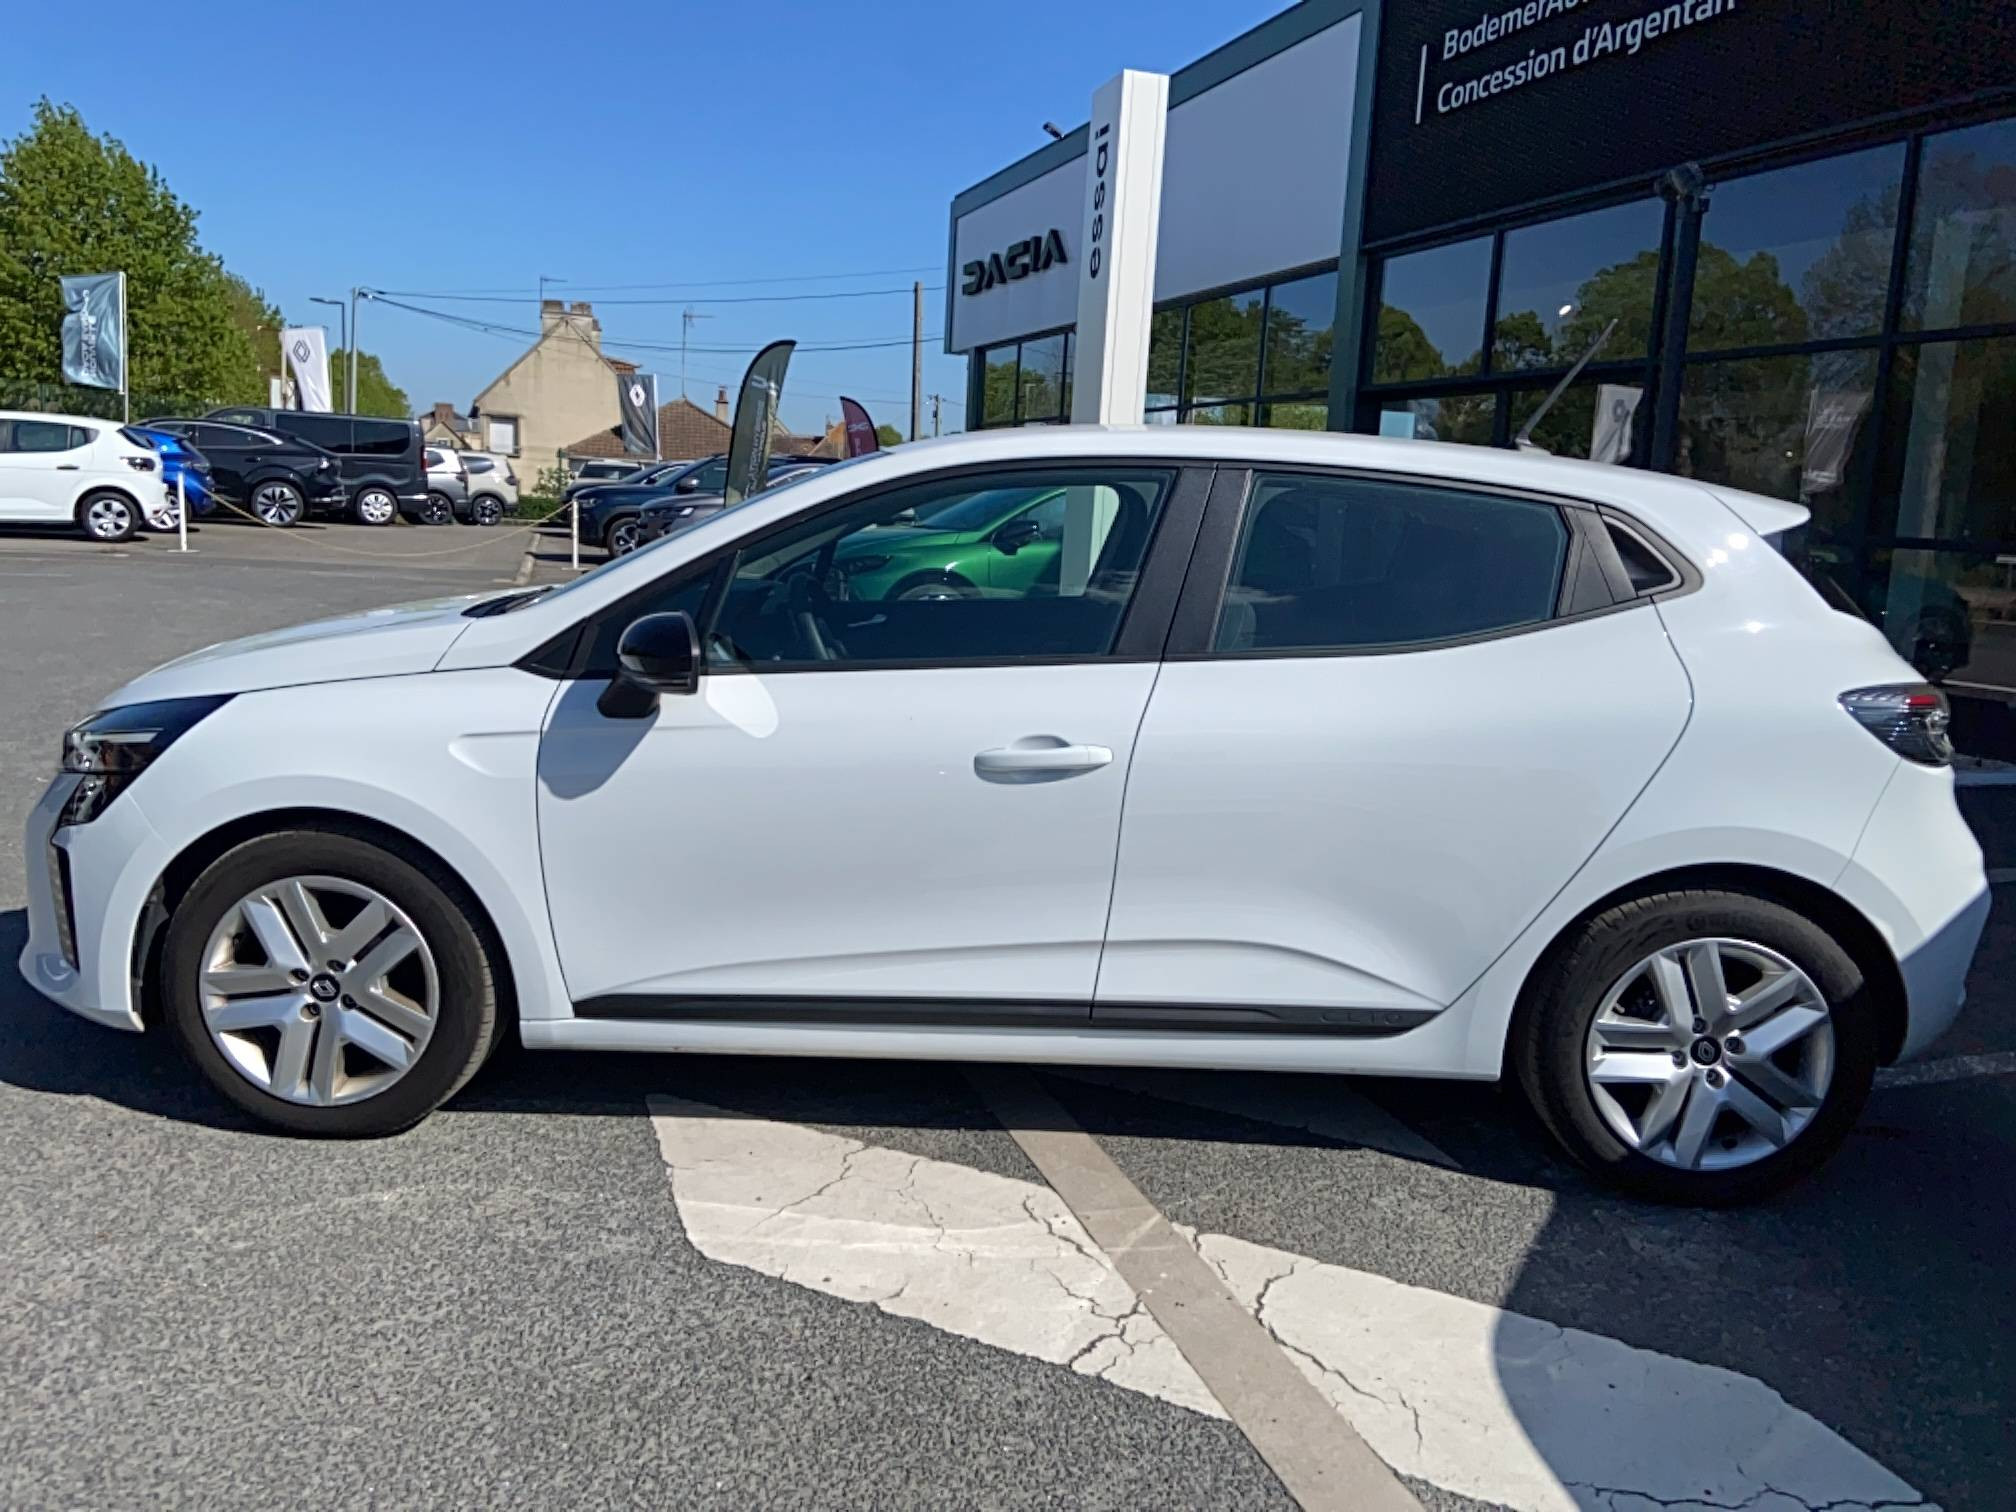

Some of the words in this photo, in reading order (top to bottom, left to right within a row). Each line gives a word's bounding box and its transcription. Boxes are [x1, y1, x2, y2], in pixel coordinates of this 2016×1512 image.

[1442, 0, 1588, 60] BodemerA
[1437, 48, 1566, 113] Concession
[1090, 123, 1110, 279] essai
[962, 228, 1068, 296] DACIA
[1321, 1010, 1402, 1026] CLIO
